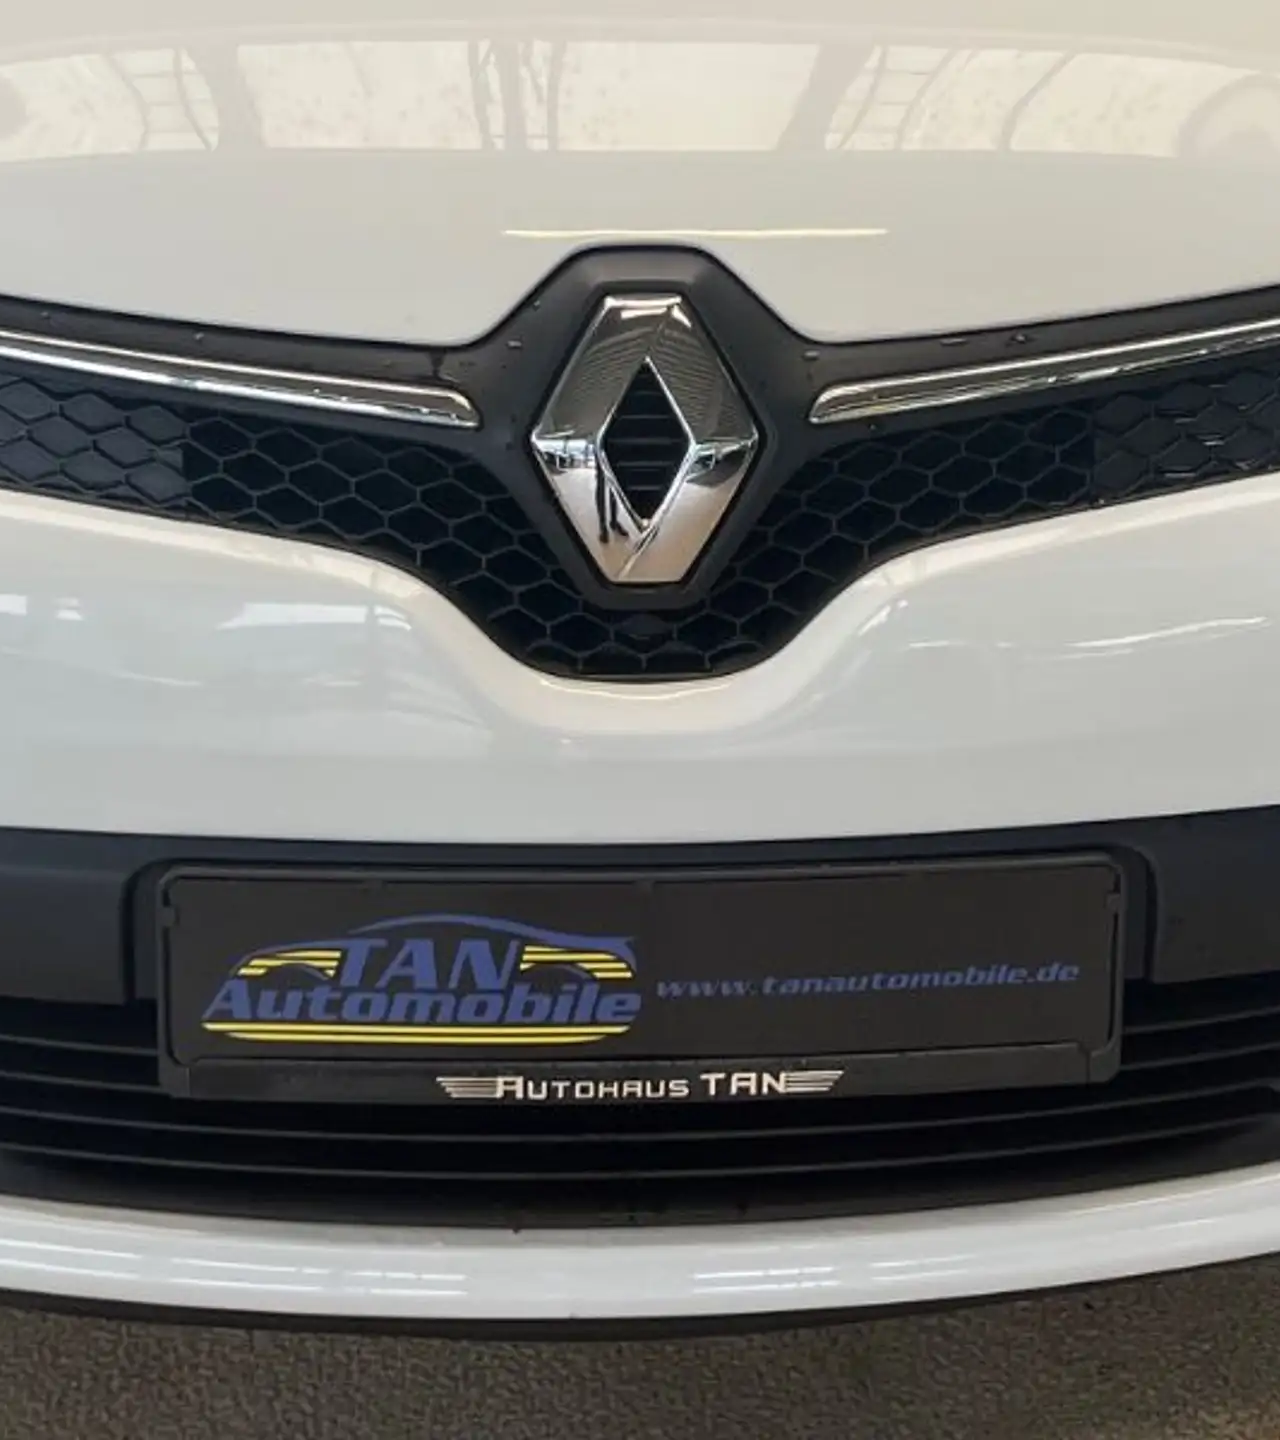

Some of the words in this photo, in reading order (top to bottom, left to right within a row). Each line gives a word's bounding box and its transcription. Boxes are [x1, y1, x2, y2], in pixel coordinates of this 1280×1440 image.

[338, 938, 520, 990] TAN
[656, 961, 1080, 1000] www.tanautomobile.de
[201, 978, 642, 1024] Automobile
[699, 1071, 787, 1096] TAN
